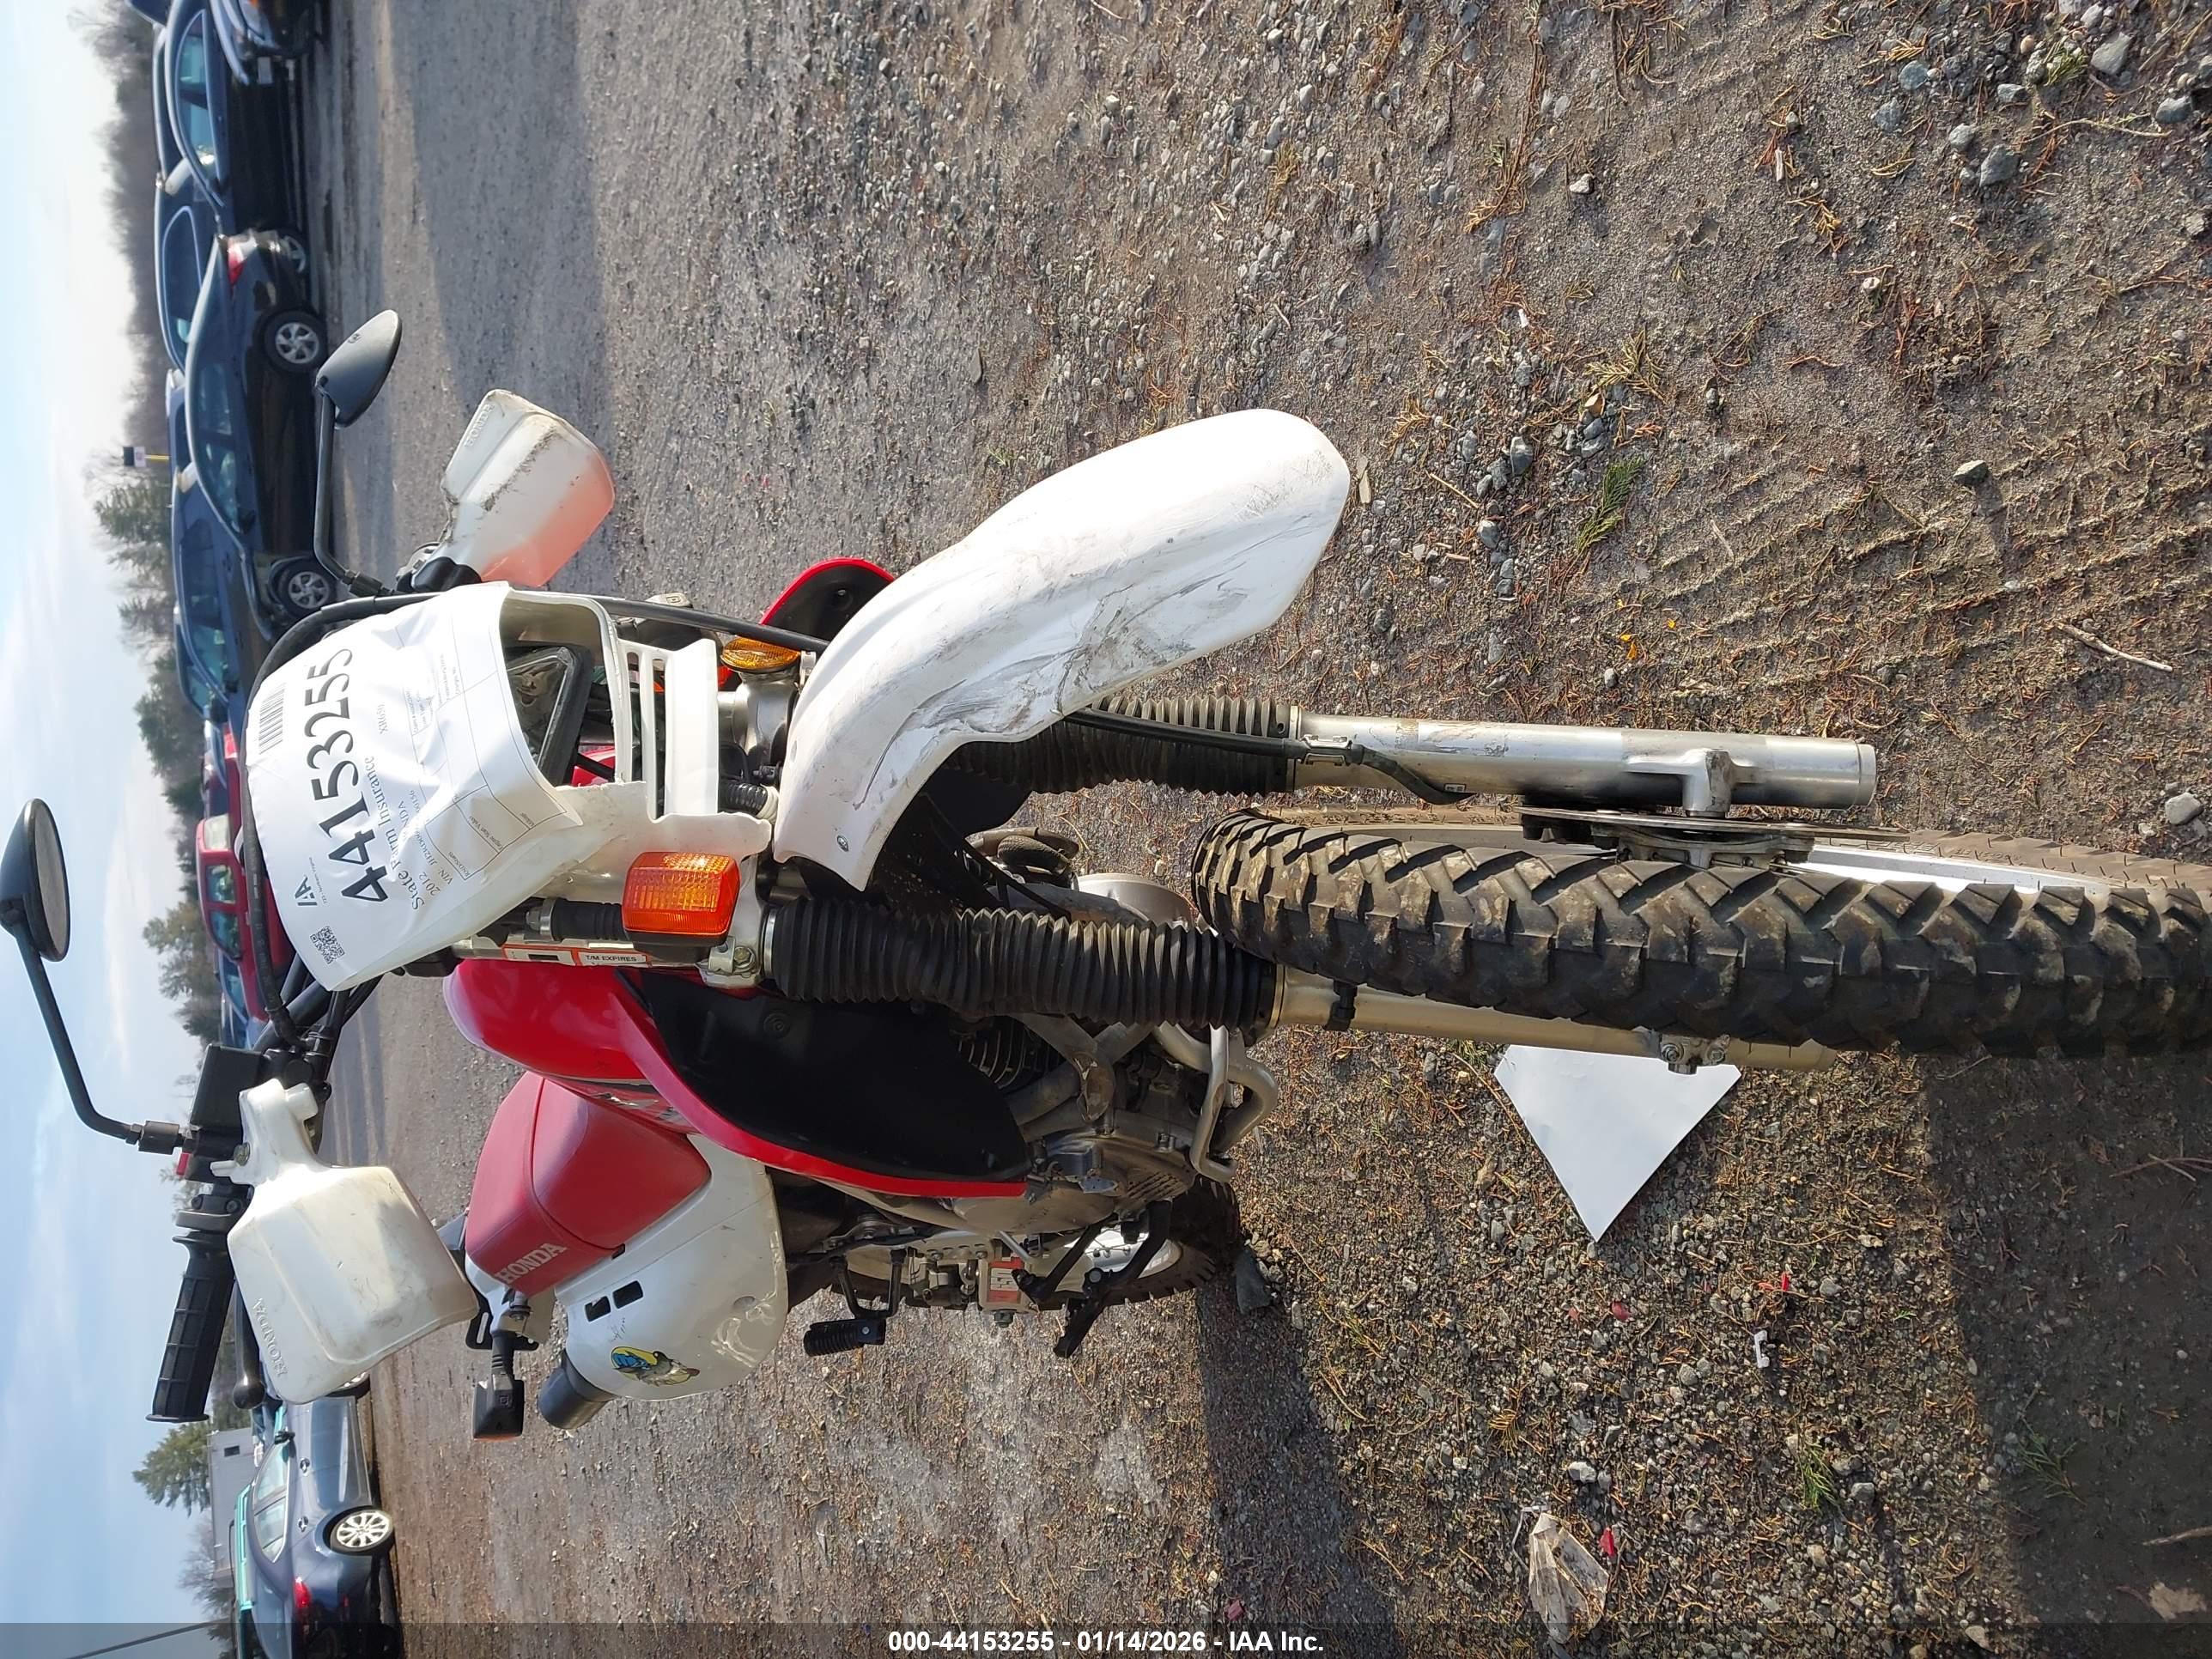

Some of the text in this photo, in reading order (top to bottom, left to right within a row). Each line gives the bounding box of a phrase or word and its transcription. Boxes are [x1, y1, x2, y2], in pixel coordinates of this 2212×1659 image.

[303, 648, 388, 902] 44153255
[363, 756, 425, 910] State Farm Insurance
[295, 877, 318, 907] IAA
[418, 872, 441, 896] 2012
[494, 1243, 568, 1284] HONDA
[252, 1297, 289, 1377] HONDA
